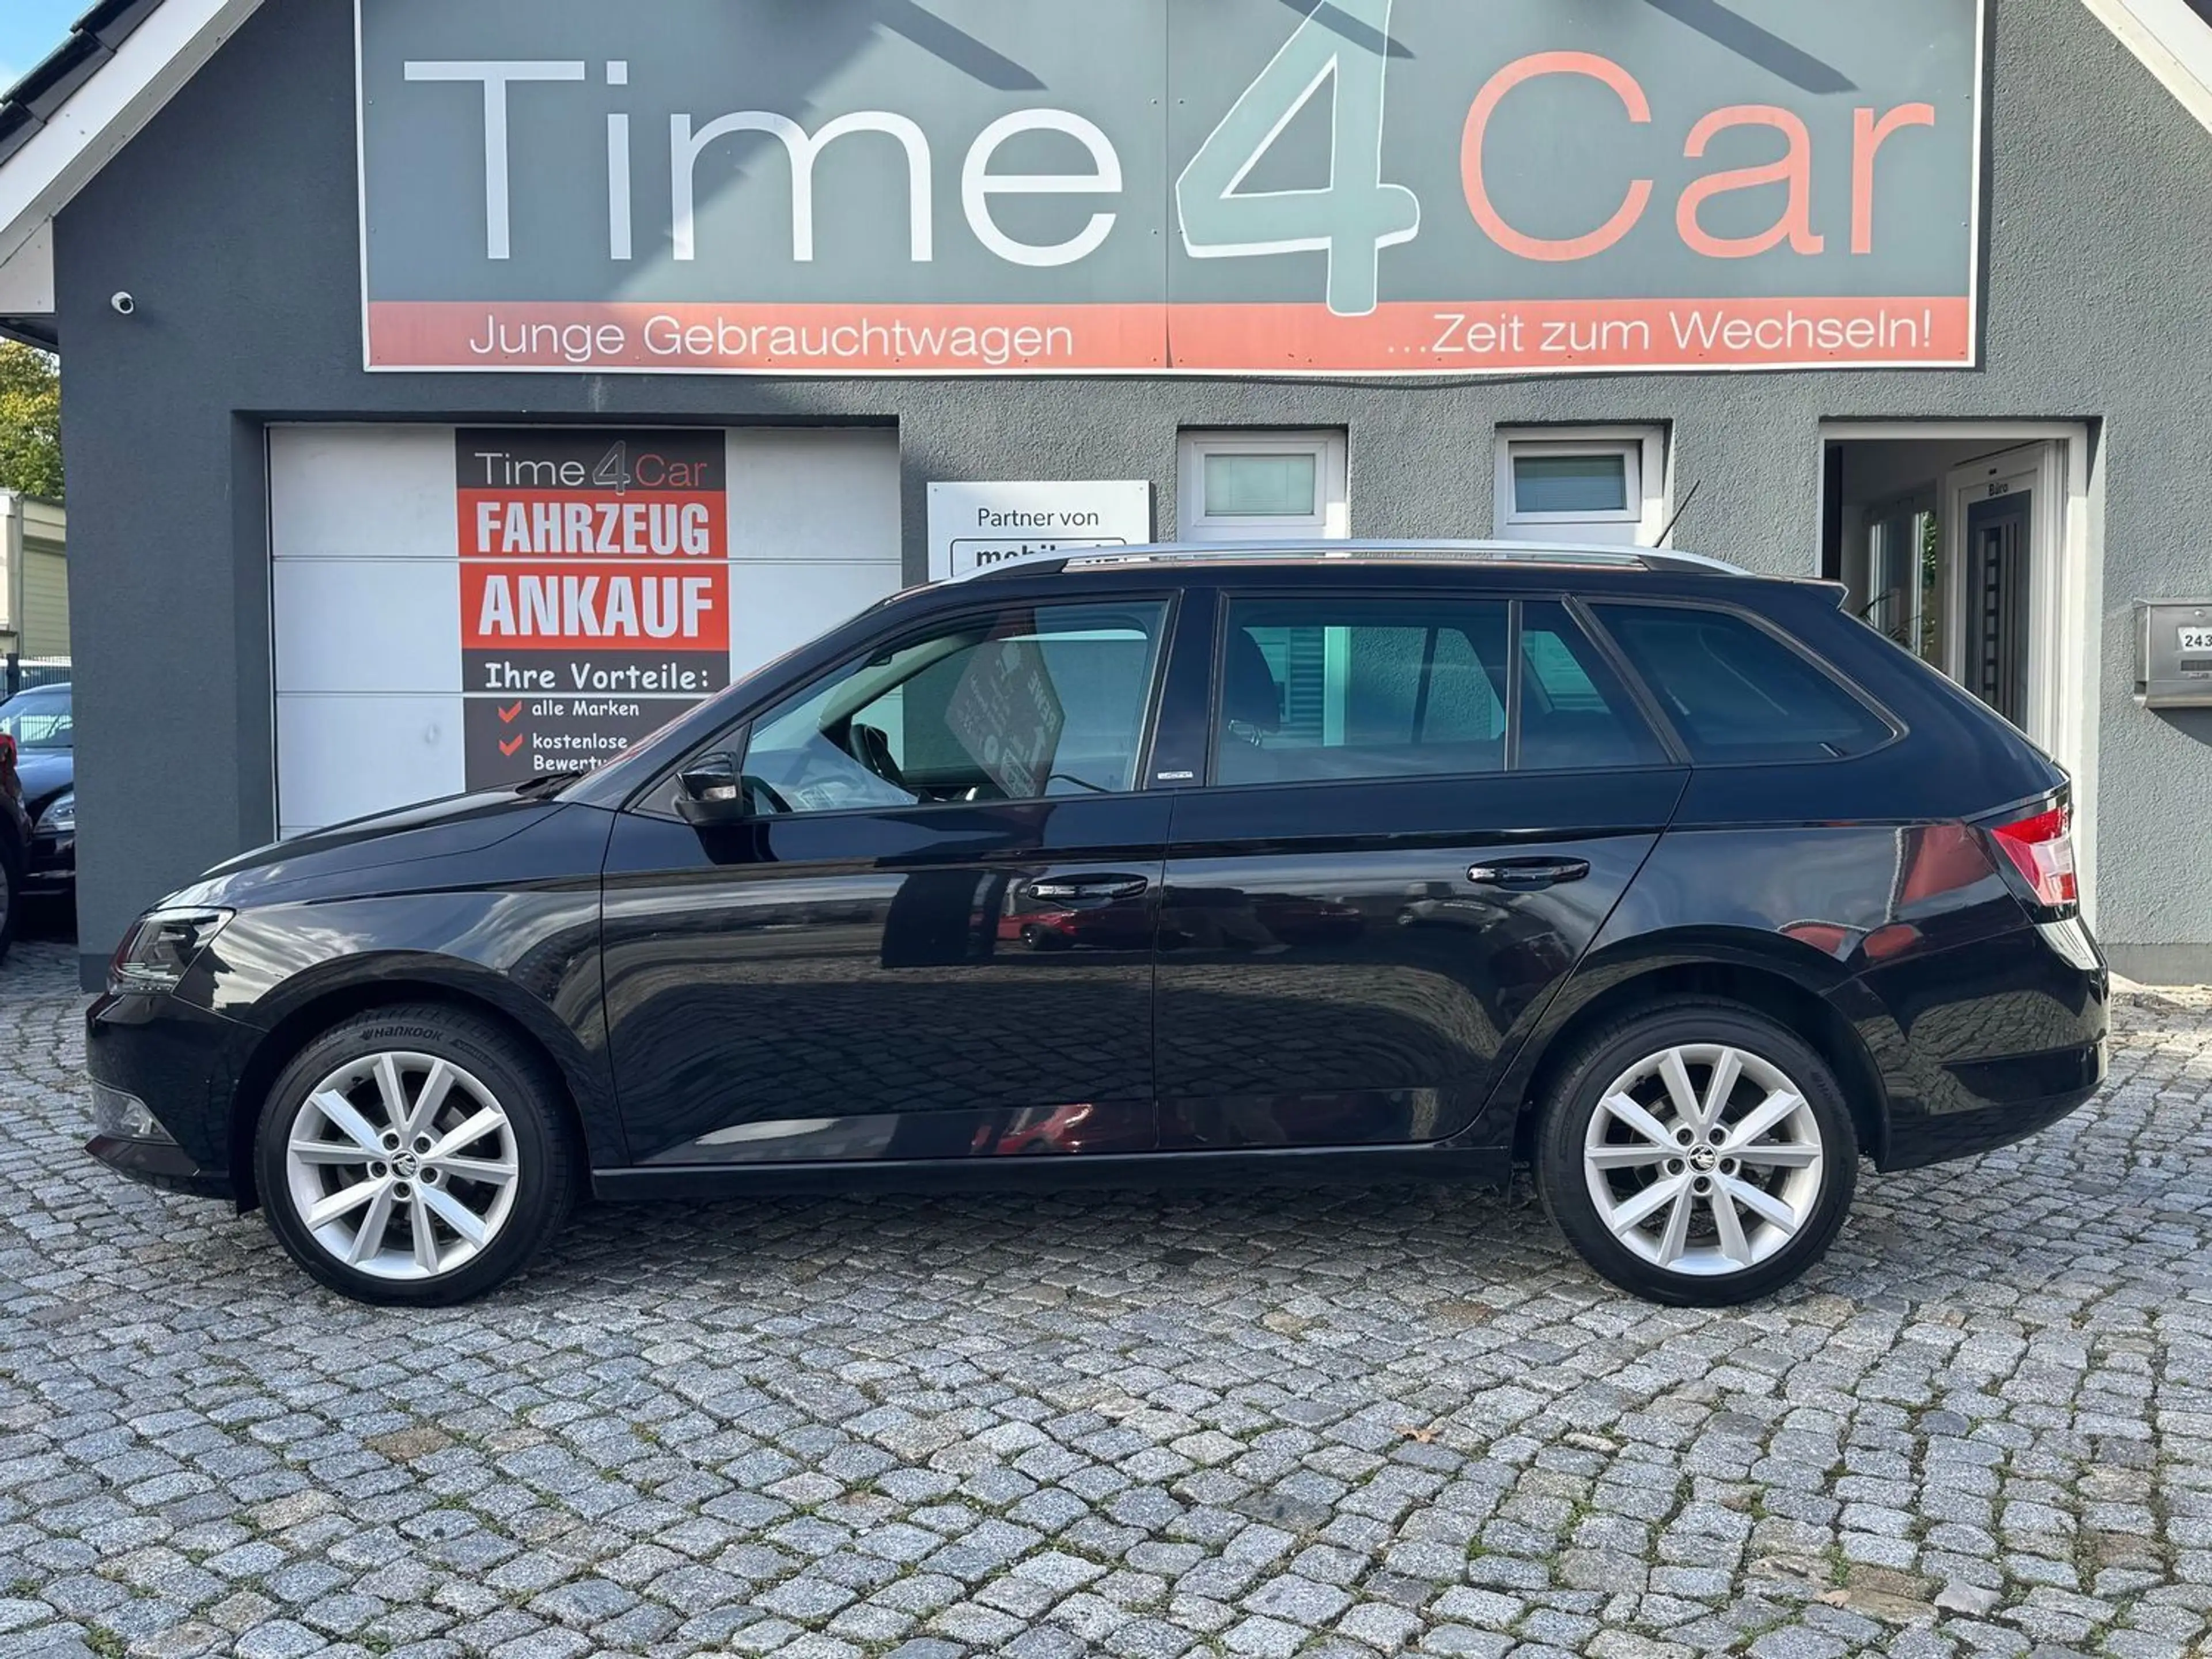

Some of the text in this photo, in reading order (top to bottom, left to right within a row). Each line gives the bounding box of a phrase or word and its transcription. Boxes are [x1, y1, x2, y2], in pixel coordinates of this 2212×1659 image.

[469, 315, 1073, 366] Junge Gebrauchtwagen
[1387, 309, 1931, 353] ...Zeit zum Wechseln!
[1988, 482, 2008, 496] Büro
[477, 501, 710, 555] FAHRZEUG
[978, 508, 1099, 527] Partner von
[479, 574, 713, 639] ANKAUF
[485, 661, 709, 690] Ihre Vorteile:
[532, 699, 639, 717] alle Marken
[533, 732, 628, 749] kostenlose
